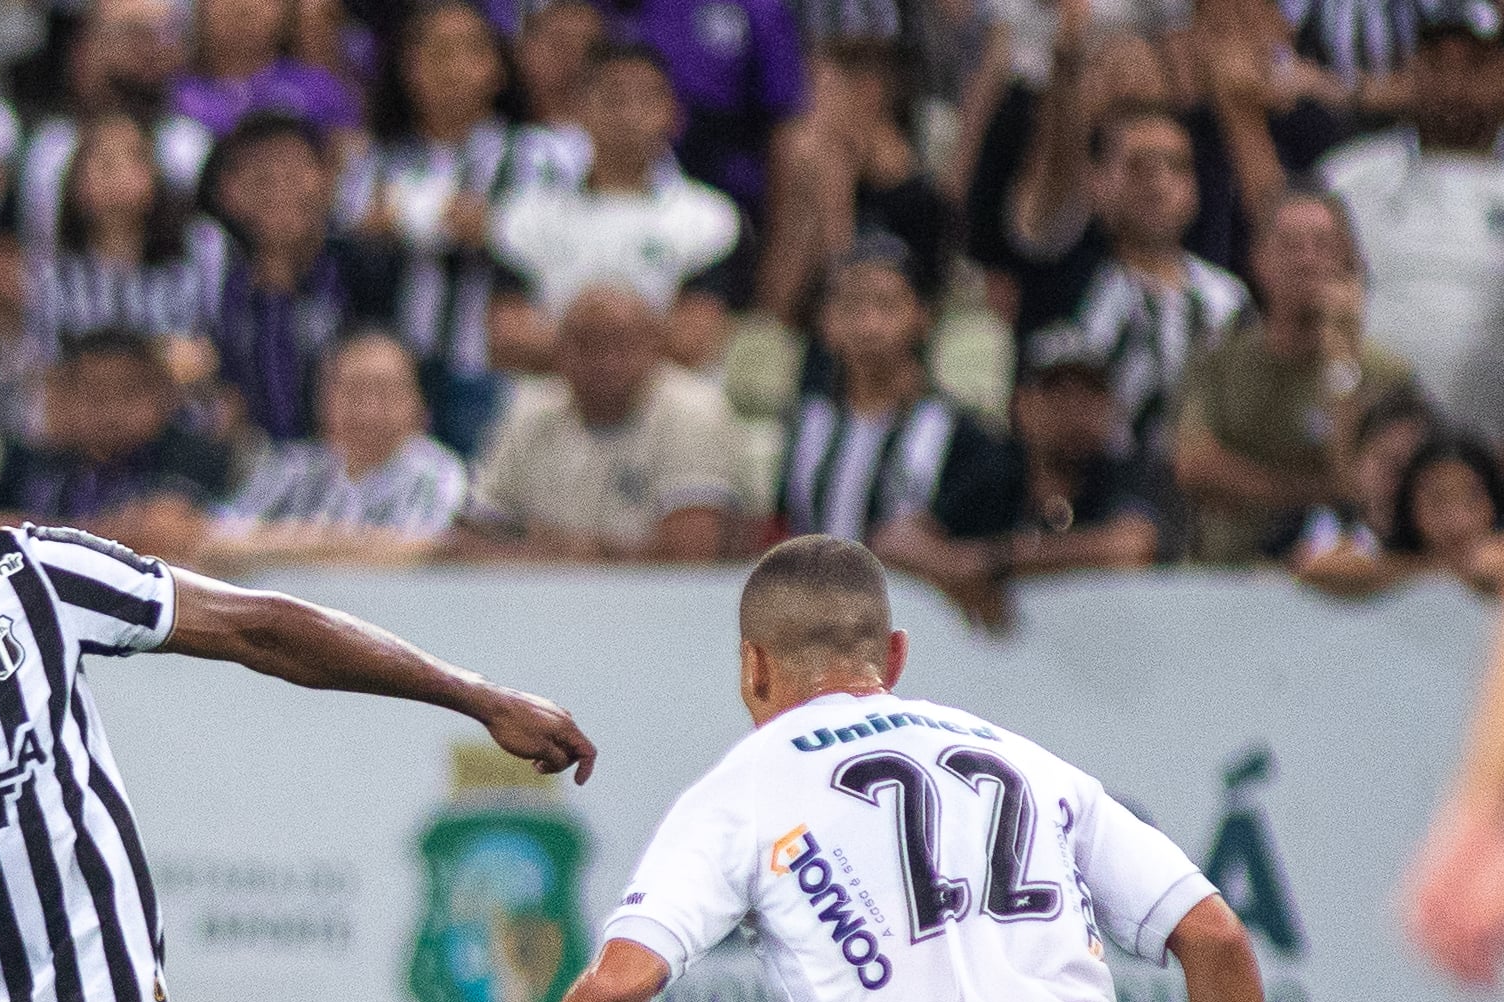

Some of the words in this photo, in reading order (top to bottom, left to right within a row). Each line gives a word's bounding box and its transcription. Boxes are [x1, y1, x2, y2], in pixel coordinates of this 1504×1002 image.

[791, 712, 1003, 752] Unimed
[788, 830, 893, 991] COMJOL
[830, 744, 1063, 945] 22
